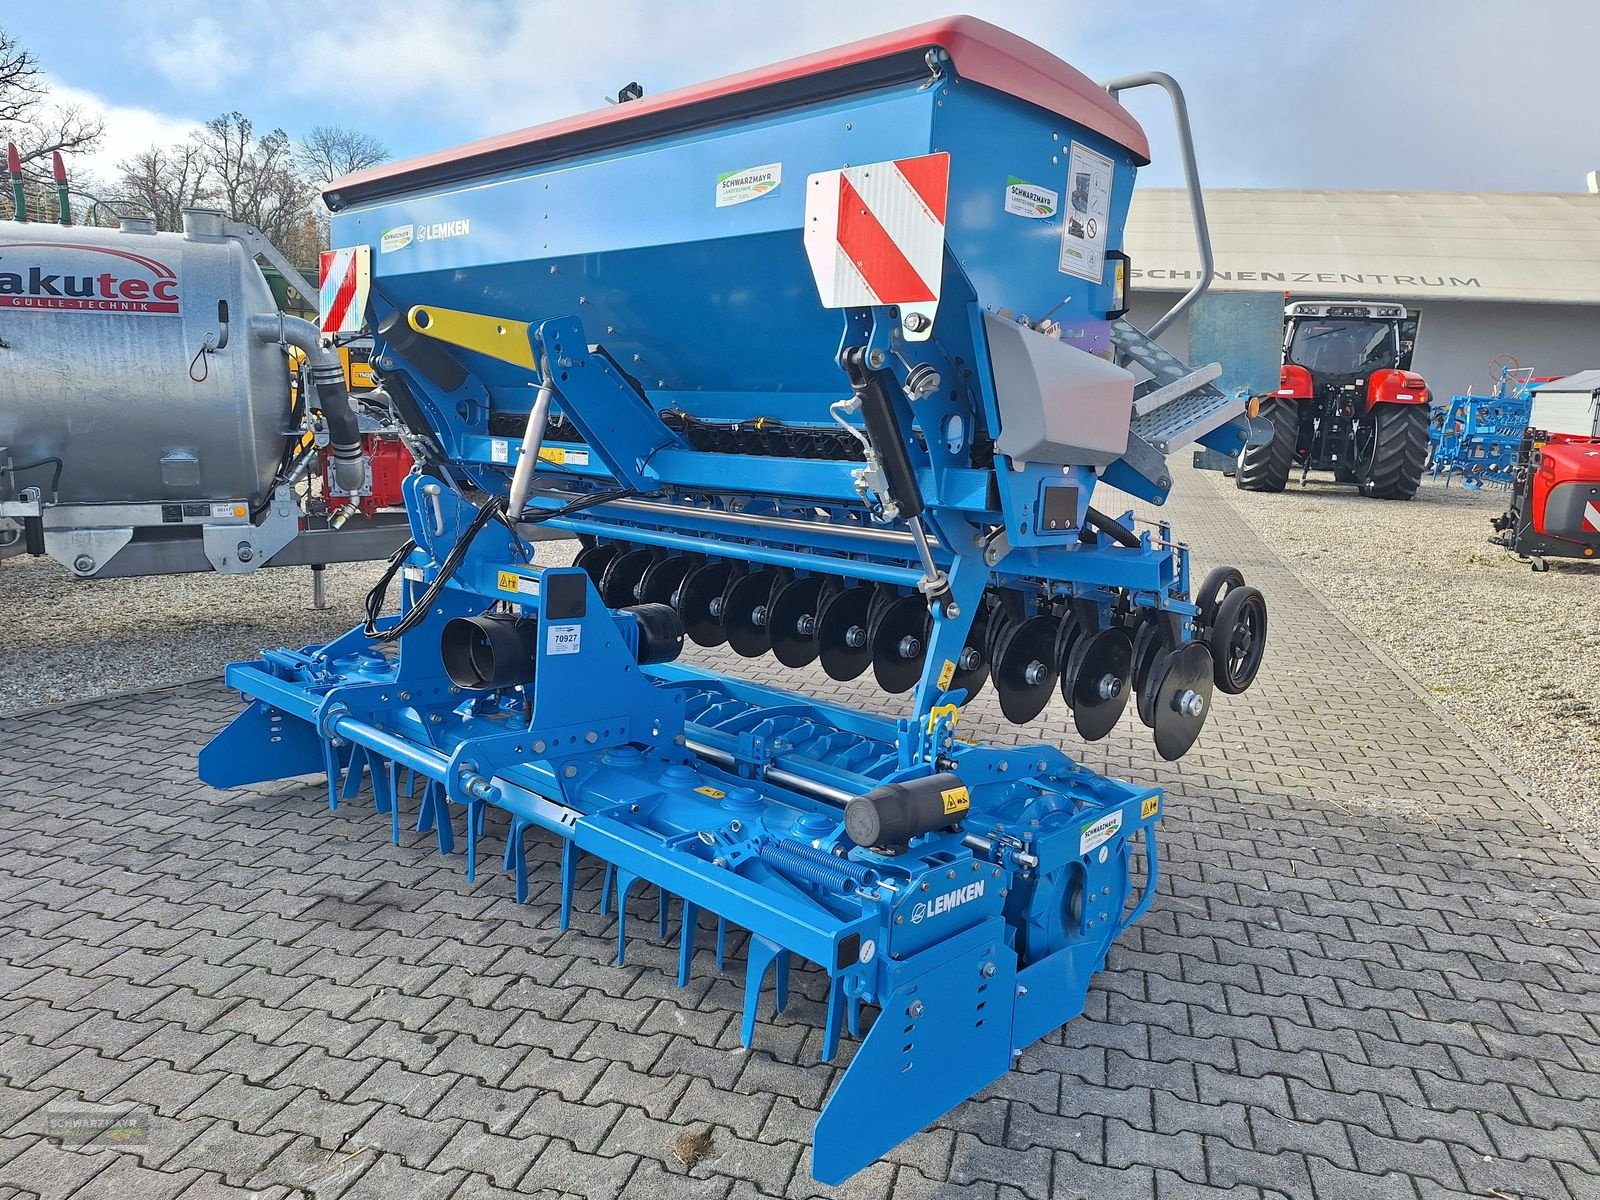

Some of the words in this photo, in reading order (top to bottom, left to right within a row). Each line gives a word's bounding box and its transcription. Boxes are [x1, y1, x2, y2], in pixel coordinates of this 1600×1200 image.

[722, 173, 772, 189] SCHWARZMAYR
[1011, 186, 1051, 205] SCHWARZMAYR
[426, 219, 470, 240] LEMKEN
[0, 257, 179, 301] akutec
[12, 297, 148, 311] GÜLLE-TECHNIK
[555, 634, 578, 643] 70927
[1084, 818, 1117, 838] SCHWARZMAYR
[926, 880, 985, 918] LEMKEN
